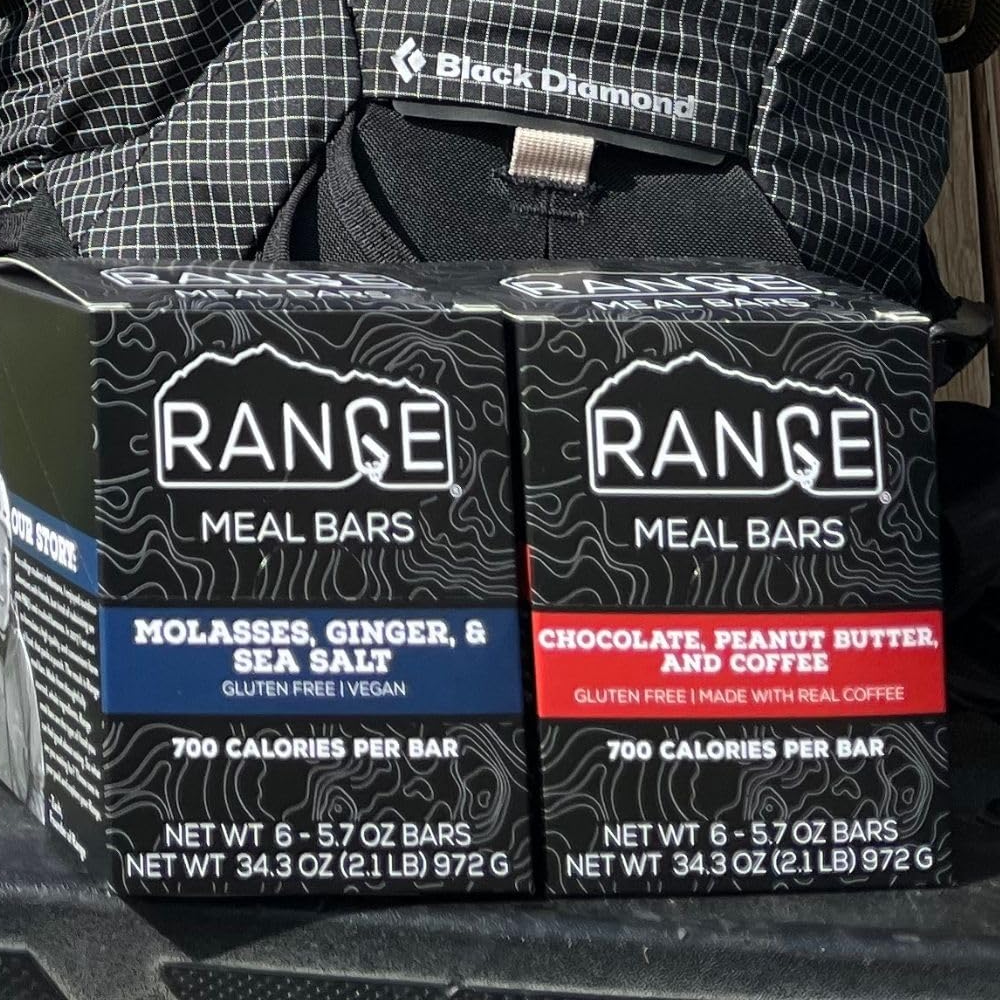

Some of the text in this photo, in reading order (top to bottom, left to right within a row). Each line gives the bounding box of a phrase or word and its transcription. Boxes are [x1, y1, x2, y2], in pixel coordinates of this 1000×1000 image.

[436, 51, 697, 119] Black Diamond
[592, 298, 811, 309] MEAL BARS
[164, 397, 445, 482] RANGE
[595, 406, 873, 487] RANGE
[11, 507, 34, 546] OUR
[202, 512, 414, 542] MEAL BARS
[635, 519, 844, 548] MEAL BARS
[135, 620, 485, 647] MOLASSES, GINGER, &
[538, 627, 938, 652] CHOCOLATE, PEANUT BUTTER,
[233, 649, 391, 673] SEA SALT
[661, 653, 828, 672] AND COFFEE
[223, 681, 288, 696] GLUTEN
[293, 681, 335, 696] FREE
[348, 681, 405, 696] VEGAN
[575, 689, 640, 703] GLUTEN
[645, 689, 686, 703] FREE
[699, 689, 747, 703] MADE
[751, 689, 794, 702] WITH
[798, 688, 840, 702] REAL
[843, 687, 904, 701] COFFEE
[172, 738, 458, 758] 700 CALORIES PER BAR
[607, 738, 884, 760] 700 CALORIES PER BAR
[166, 823, 215, 847] NET
[221, 823, 263, 847] WT
[276, 823, 292, 847] 6
[318, 823, 354, 847] 5.7
[361, 823, 395, 847] OZ
[403, 822, 471, 846] BARS
[604, 823, 653, 846] NET
[658, 823, 700, 846] WT
[711, 823, 727, 845] 6
[752, 821, 787, 845] 5.7
[792, 821, 826, 844] OZ
[833, 819, 898, 843] BARS
[127, 851, 508, 878] NET WT 34.3 OZ (2.1 LB) 972 G
[567, 846, 932, 876] NET WT 34.3 OZ (2.1 LB) 972 G
